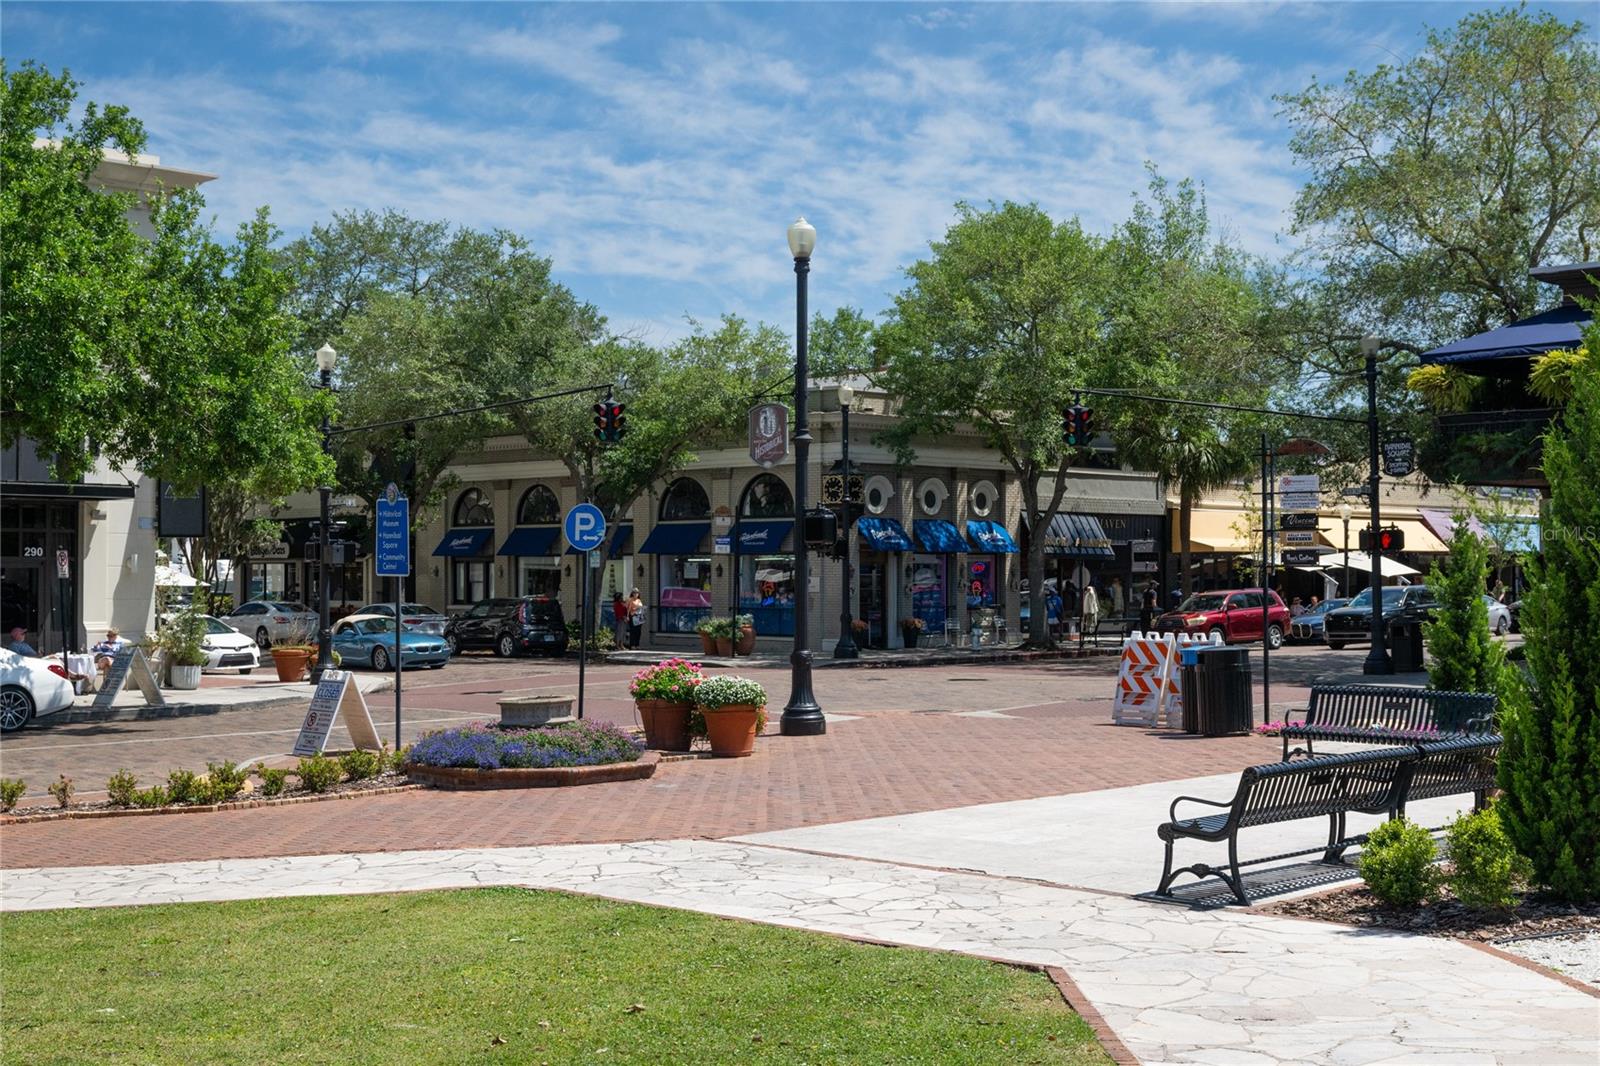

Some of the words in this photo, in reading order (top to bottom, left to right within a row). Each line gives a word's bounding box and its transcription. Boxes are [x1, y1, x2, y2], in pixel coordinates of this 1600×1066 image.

[1287, 514, 1316, 525] Vincent
[574, 513, 595, 541] P
[382, 541, 398, 549] Square
[23, 546, 44, 557] 290
[382, 553, 406, 562] Community
[382, 562, 397, 570] Center
[317, 689, 341, 698] CLOSED
